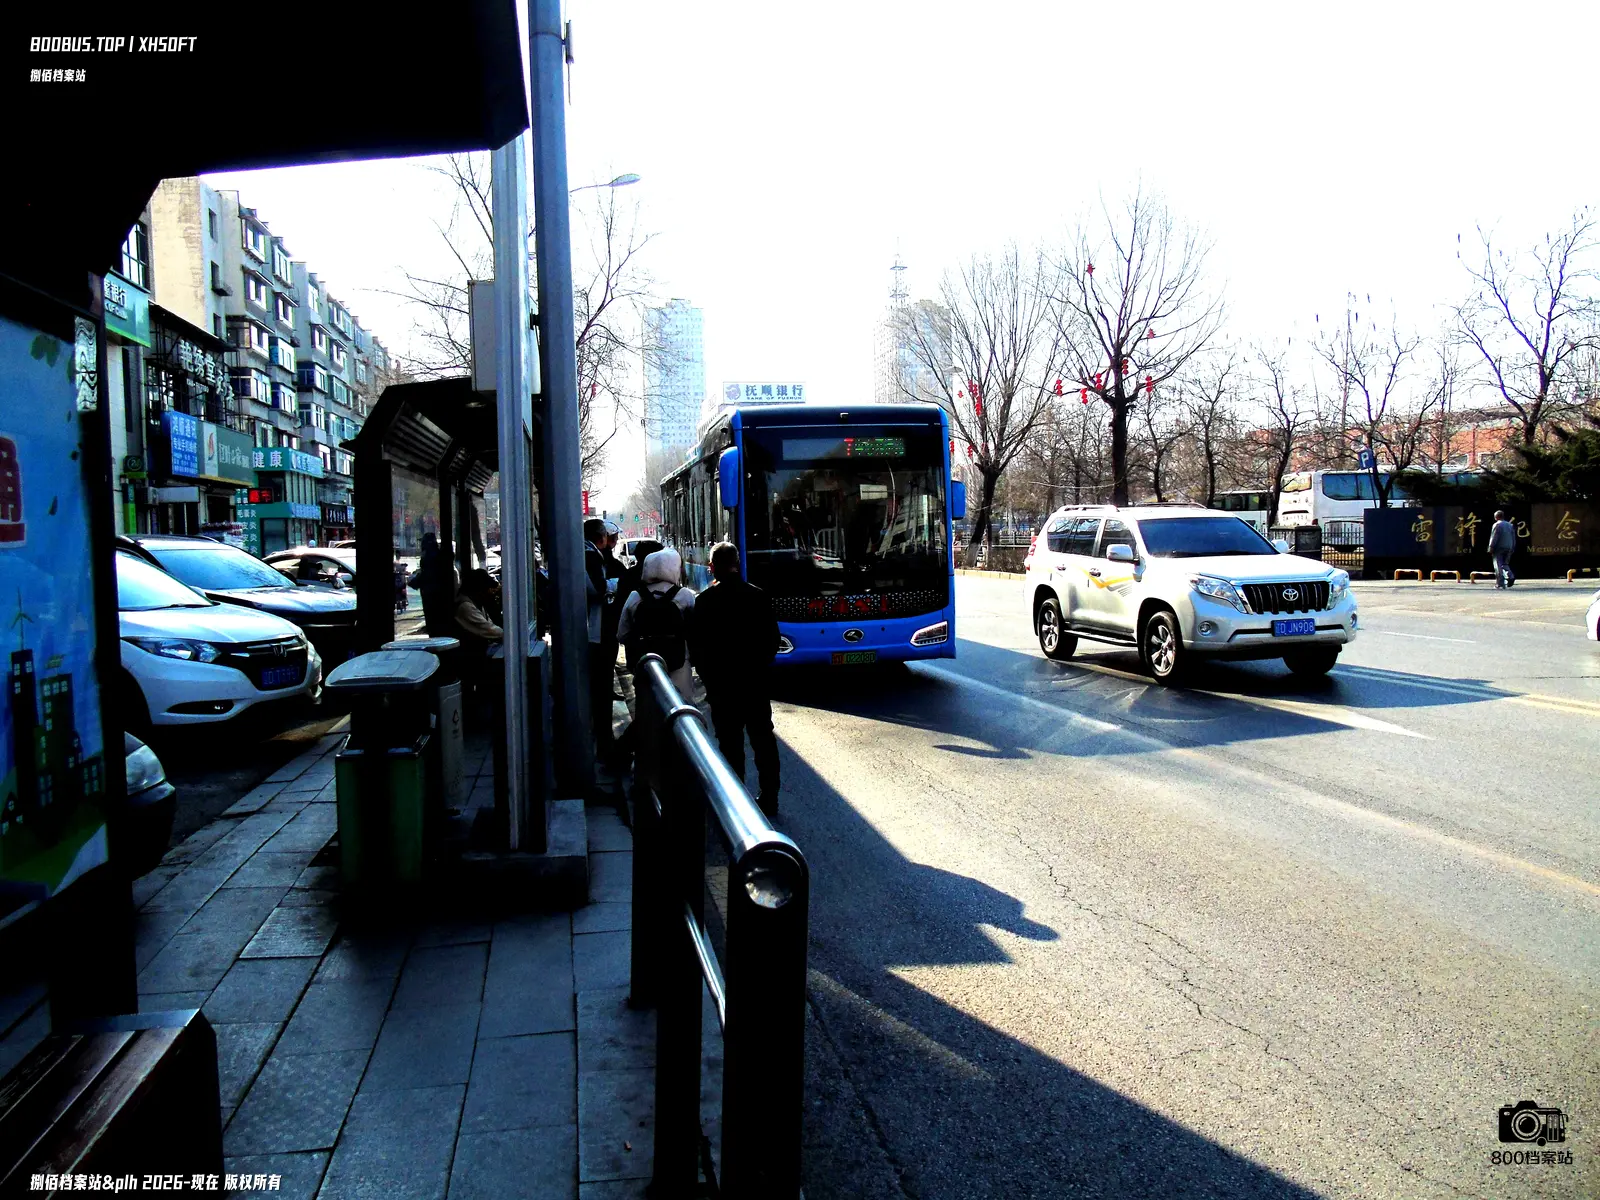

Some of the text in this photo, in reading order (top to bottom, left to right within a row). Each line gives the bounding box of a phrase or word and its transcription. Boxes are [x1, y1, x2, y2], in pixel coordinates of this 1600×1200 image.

[745, 384, 804, 397] 抚顺银行
[252, 450, 283, 468] 健康
[1360, 451, 1369, 467] P
[1526, 545, 1581, 553] Memorial
